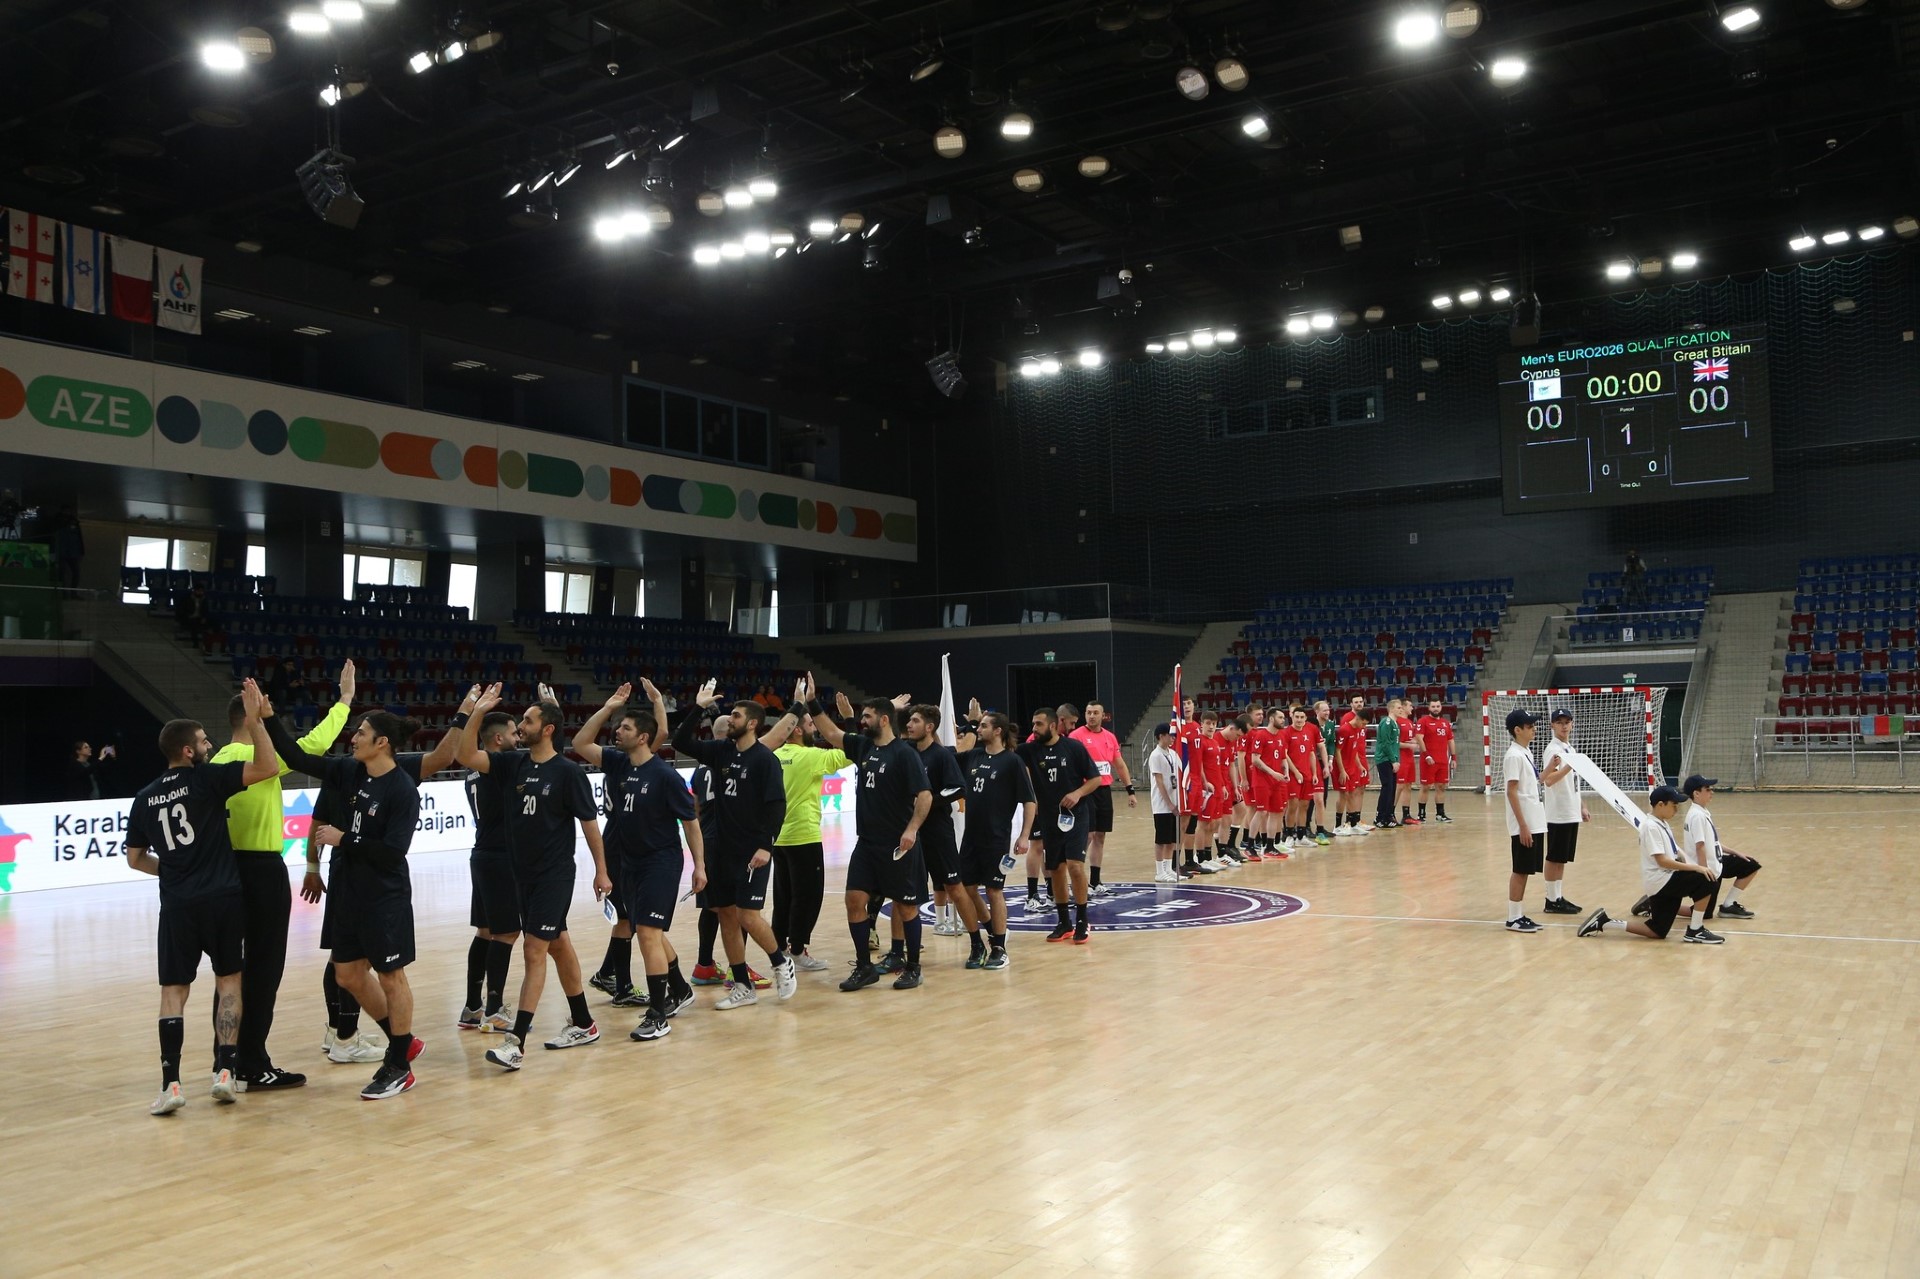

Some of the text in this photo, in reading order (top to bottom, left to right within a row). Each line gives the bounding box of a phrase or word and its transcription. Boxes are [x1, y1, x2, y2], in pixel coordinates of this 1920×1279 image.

[163, 299, 197, 313] AHF
[1521, 353, 1555, 366] Men's
[1558, 344, 1624, 362] EURO2026
[1673, 348, 1708, 362] Great
[1520, 368, 1560, 381] Cyprus
[1587, 370, 1661, 399] 00:00
[50, 388, 130, 429] AZE
[1689, 385, 1729, 413] 00
[1527, 404, 1562, 431] 00
[1620, 423, 1631, 445] 1
[1602, 464, 1610, 476] 0
[1648, 460, 1657, 473] 0
[523, 795, 537, 816] 20
[624, 793, 635, 812] 21
[158, 803, 195, 851] 13
[55, 839, 76, 861] is
[1116, 899, 1201, 918] EHF
